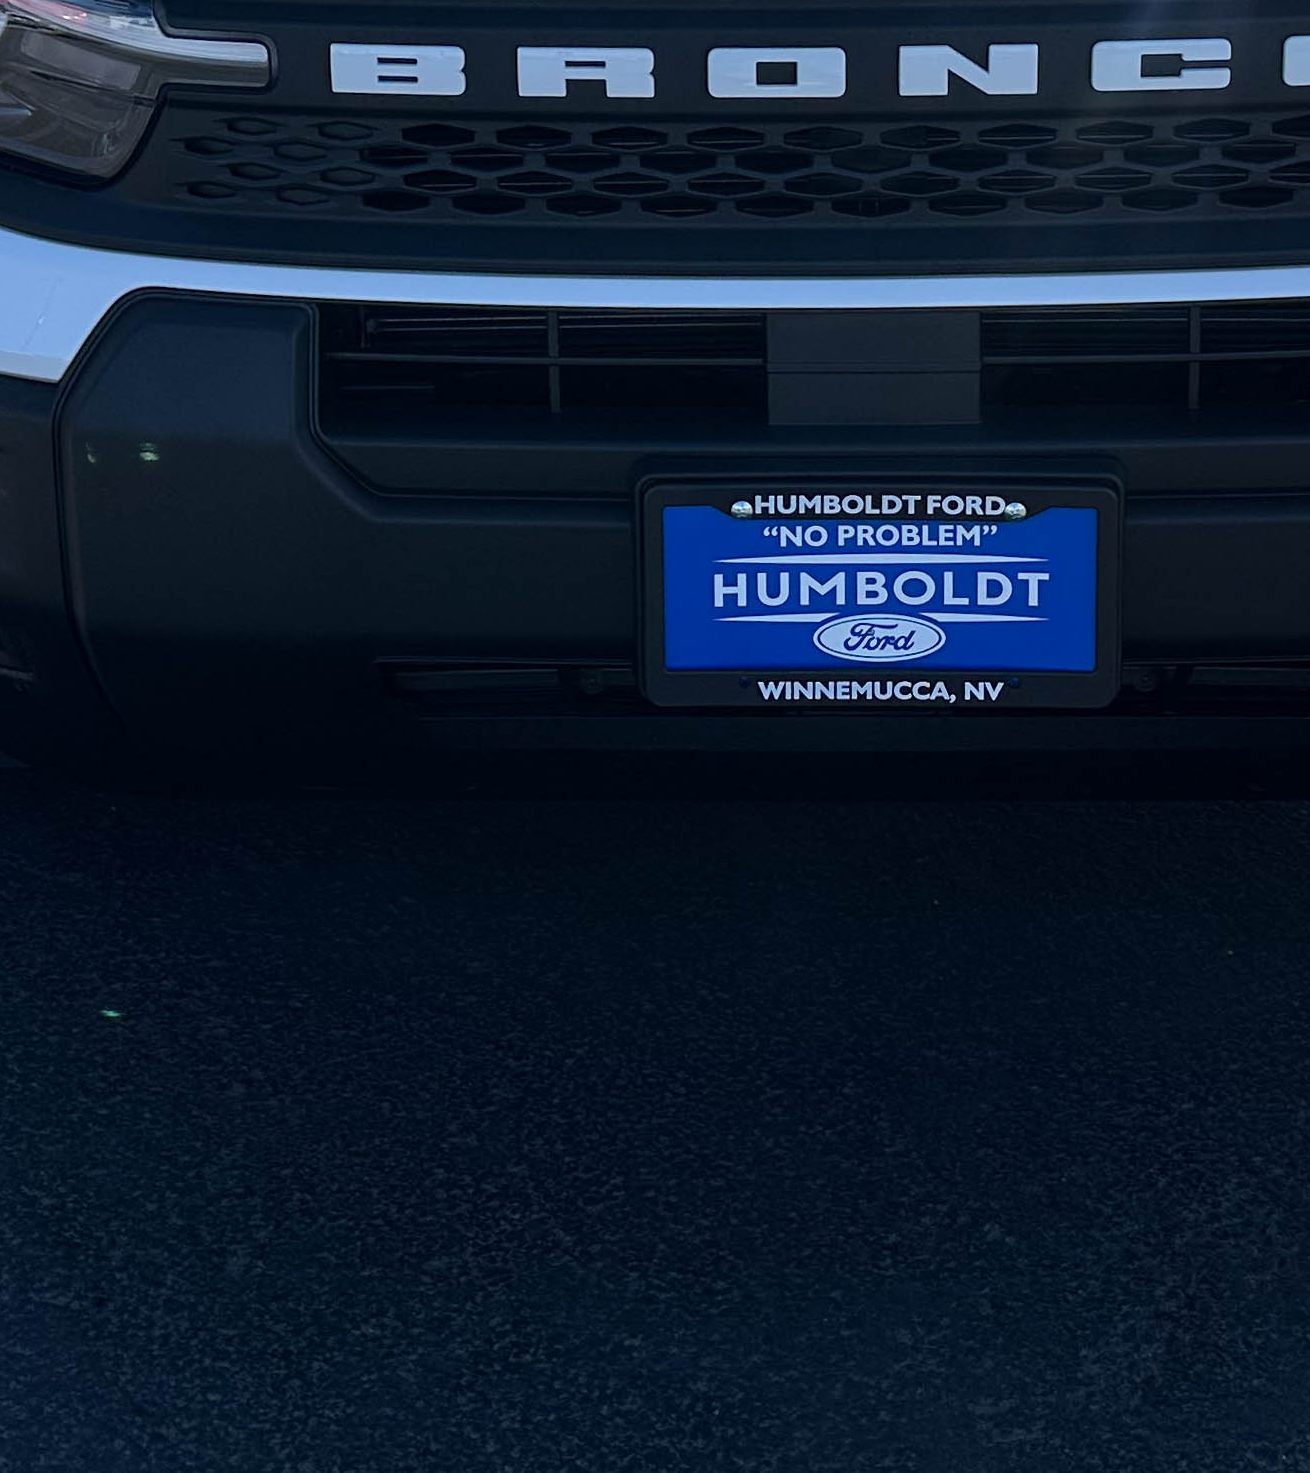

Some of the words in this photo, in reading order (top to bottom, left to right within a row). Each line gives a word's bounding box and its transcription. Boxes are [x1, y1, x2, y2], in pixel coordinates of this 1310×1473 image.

[755, 495, 921, 516] HUMBOLDT
[926, 495, 1007, 516] FORD
[713, 570, 1051, 608] HUMBOLDT
[843, 621, 915, 653] Ford
[758, 680, 957, 704] WINNEMUCCA,
[964, 682, 1005, 701] NV
